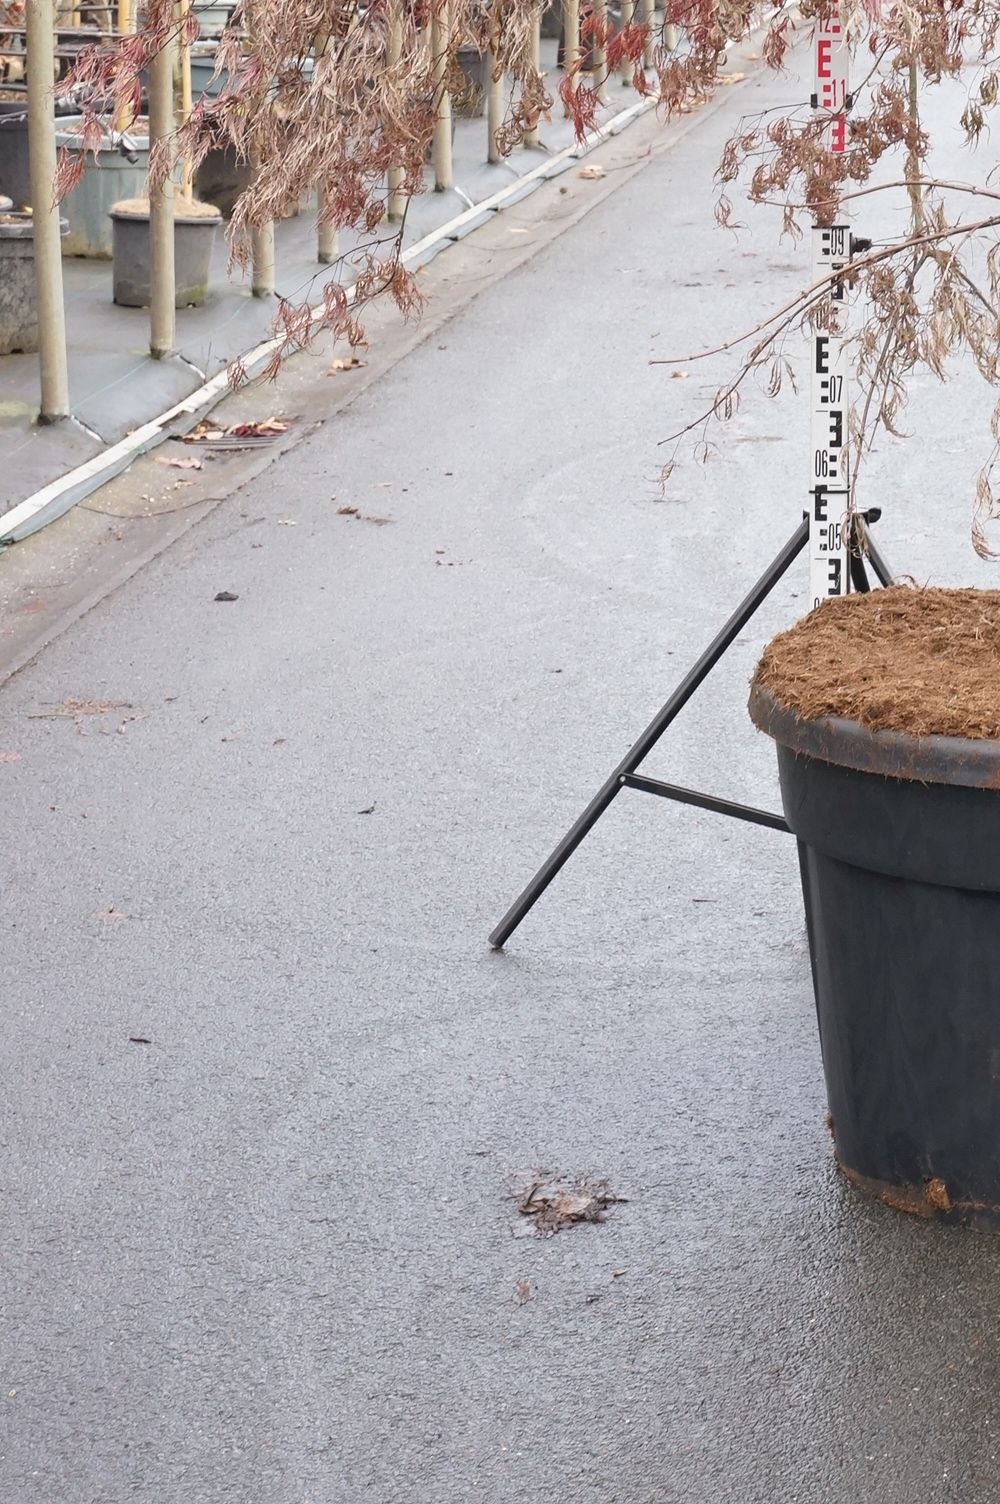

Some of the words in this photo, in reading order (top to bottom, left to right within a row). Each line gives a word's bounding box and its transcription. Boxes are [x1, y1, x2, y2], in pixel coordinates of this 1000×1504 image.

[831, 79, 846, 107] 11
[830, 228, 845, 256] 09
[829, 375, 843, 404] 07
[814, 449, 828, 478] 06
[828, 523, 842, 551] 05
